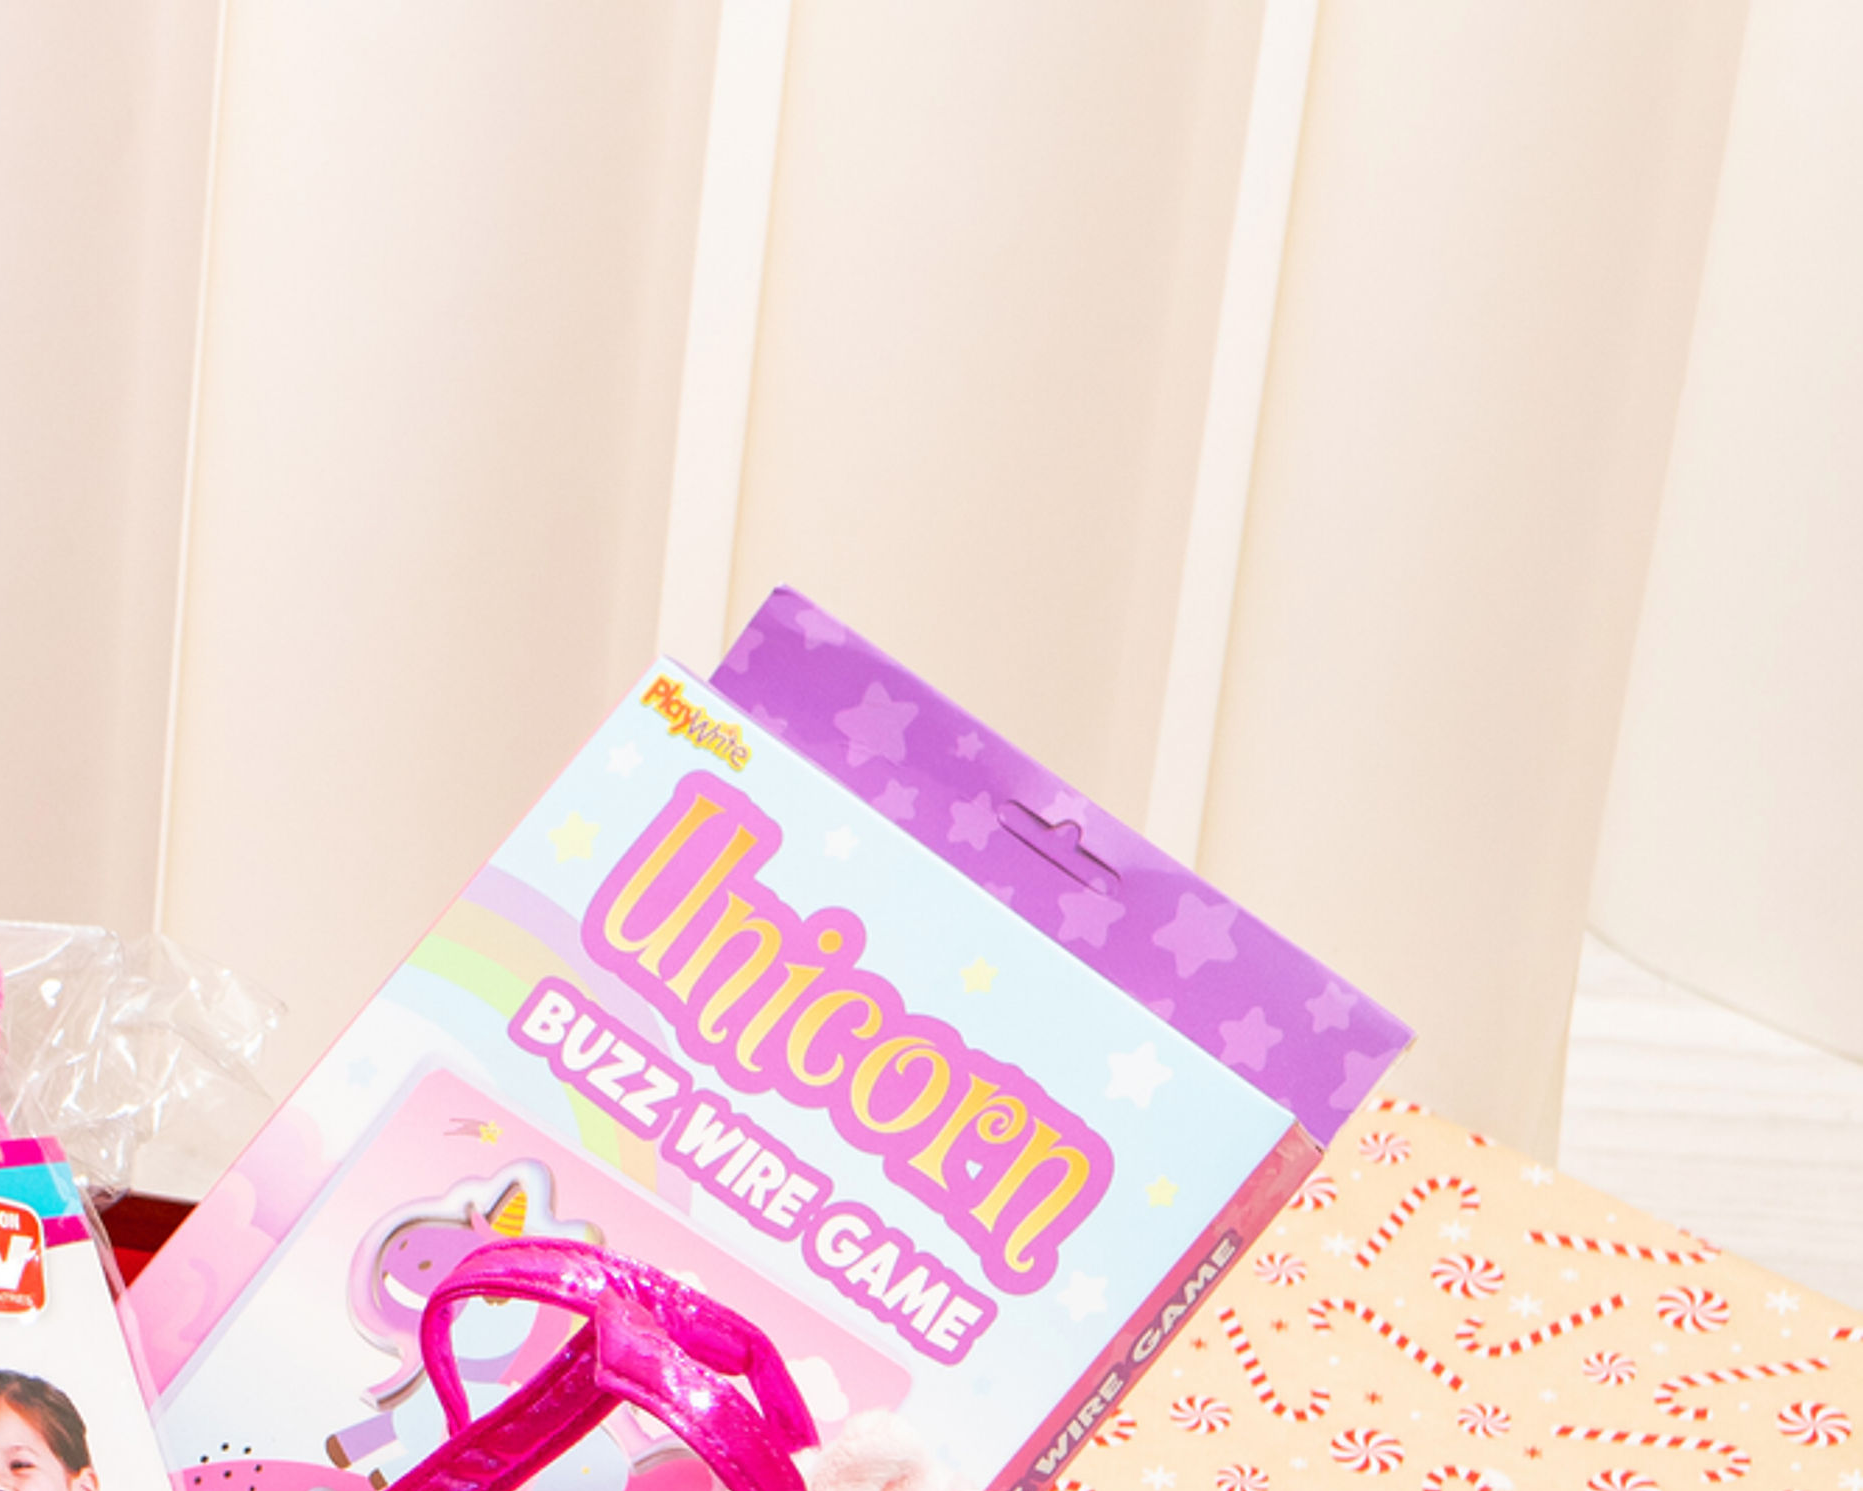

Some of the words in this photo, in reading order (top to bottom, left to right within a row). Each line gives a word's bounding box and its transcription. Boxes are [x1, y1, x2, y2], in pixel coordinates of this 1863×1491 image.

[642, 676, 750, 769] PlayWrite
[520, 988, 683, 1129] BUZZ
[674, 1100, 819, 1231] WIRE
[813, 1210, 984, 1353] GAME
[602, 793, 1092, 1275] Unicorn
[1034, 1371, 1125, 1476] WIRE
[1131, 1237, 1237, 1364] GAME
